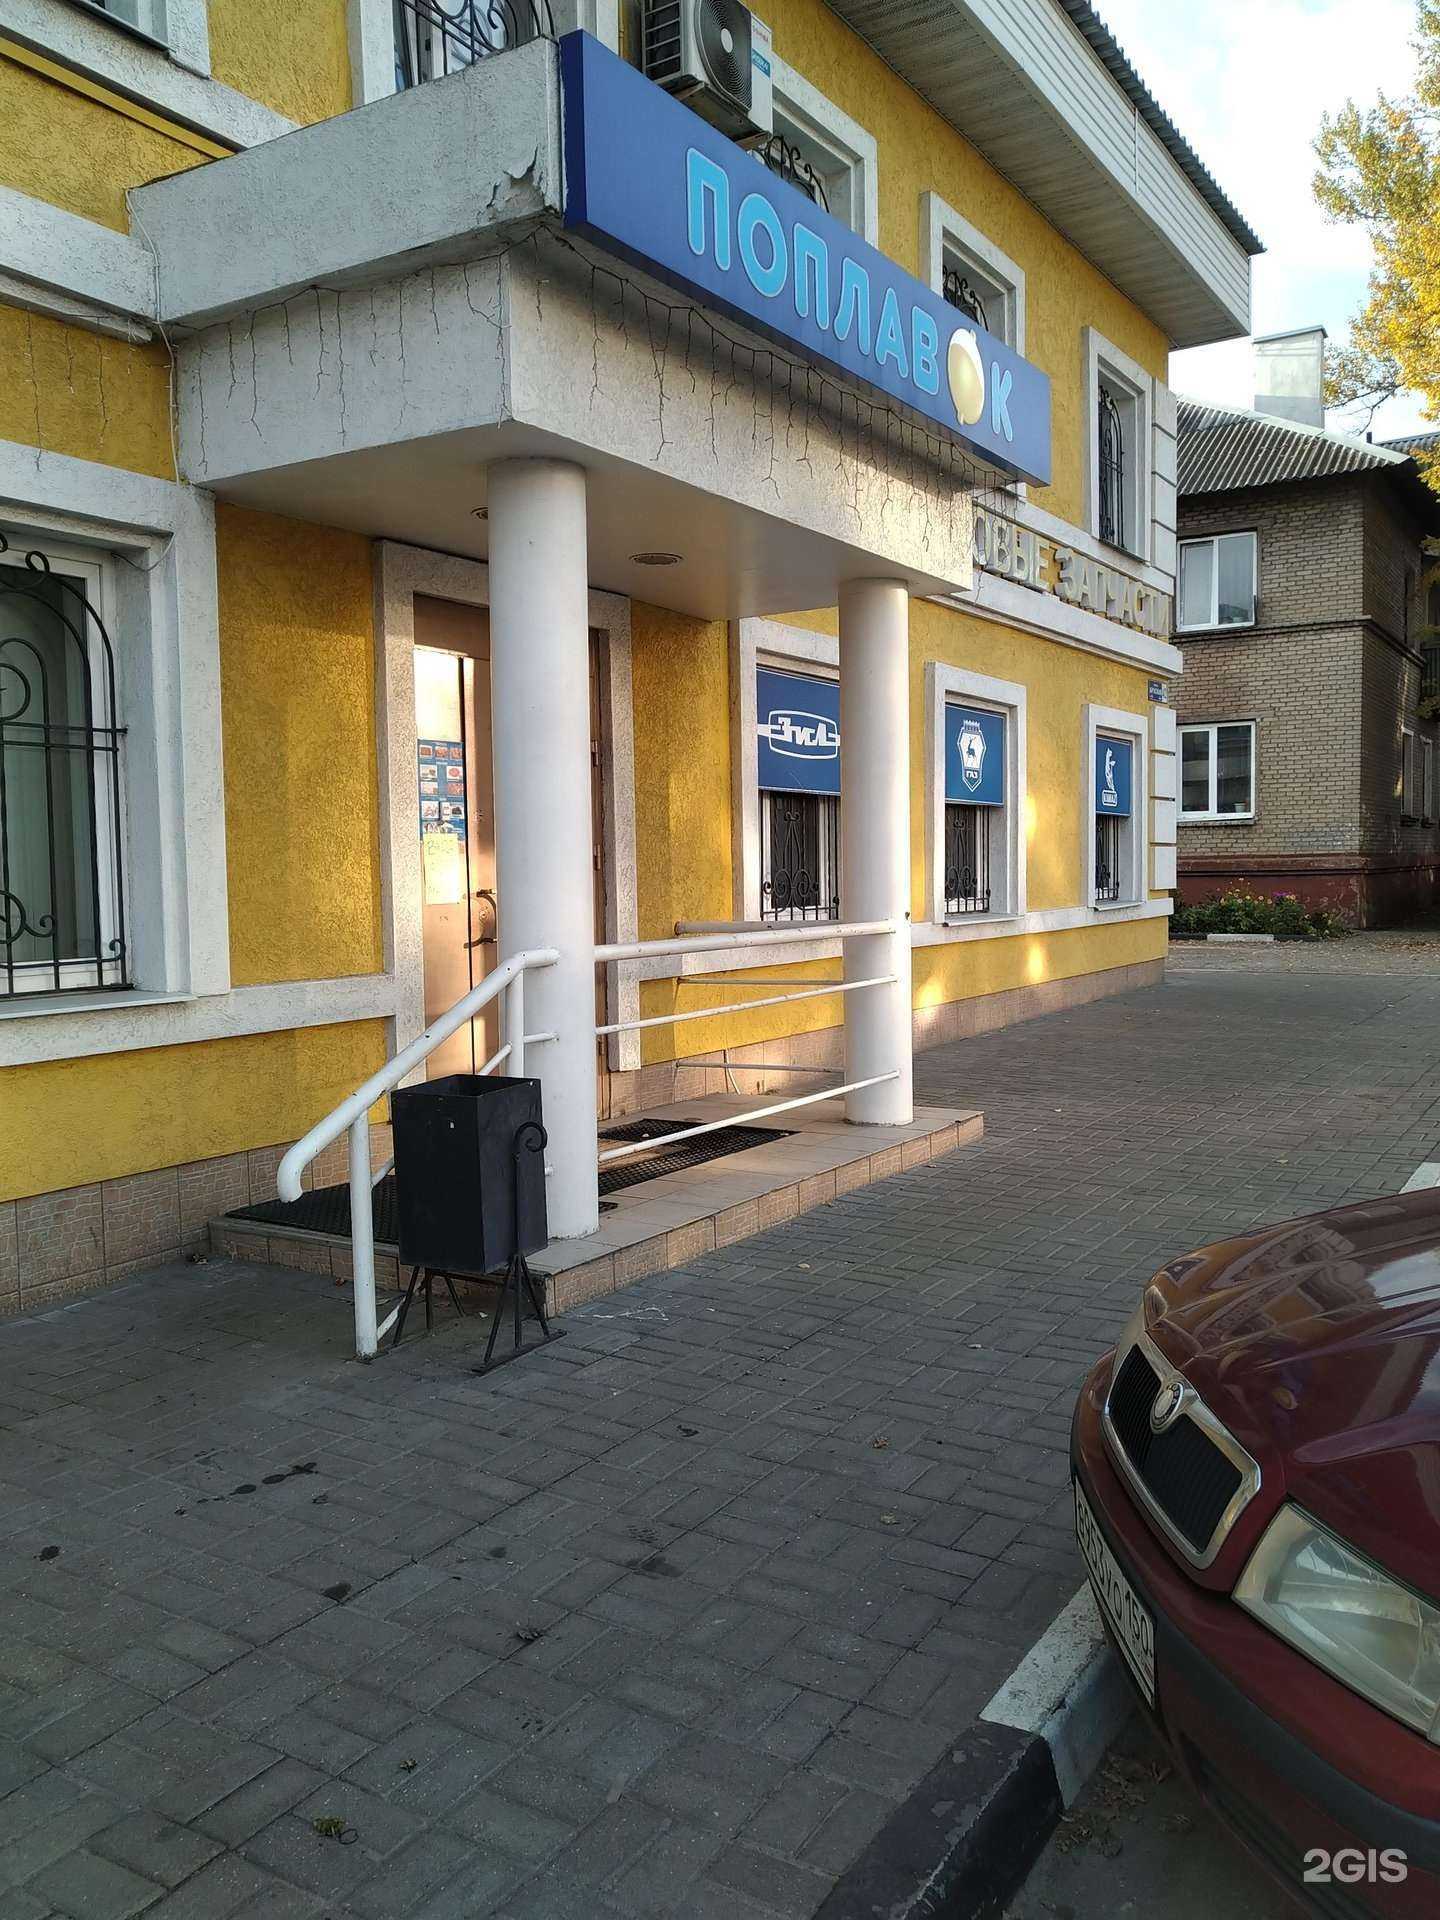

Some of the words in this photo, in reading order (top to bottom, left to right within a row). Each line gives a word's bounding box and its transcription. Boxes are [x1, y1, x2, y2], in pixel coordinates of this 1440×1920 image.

[686, 147, 1014, 442] ПОПЛАВОК
[972, 506, 1051, 594] ОВЫЕ
[1054, 547, 1169, 636] ЗАПЧАСТИ
